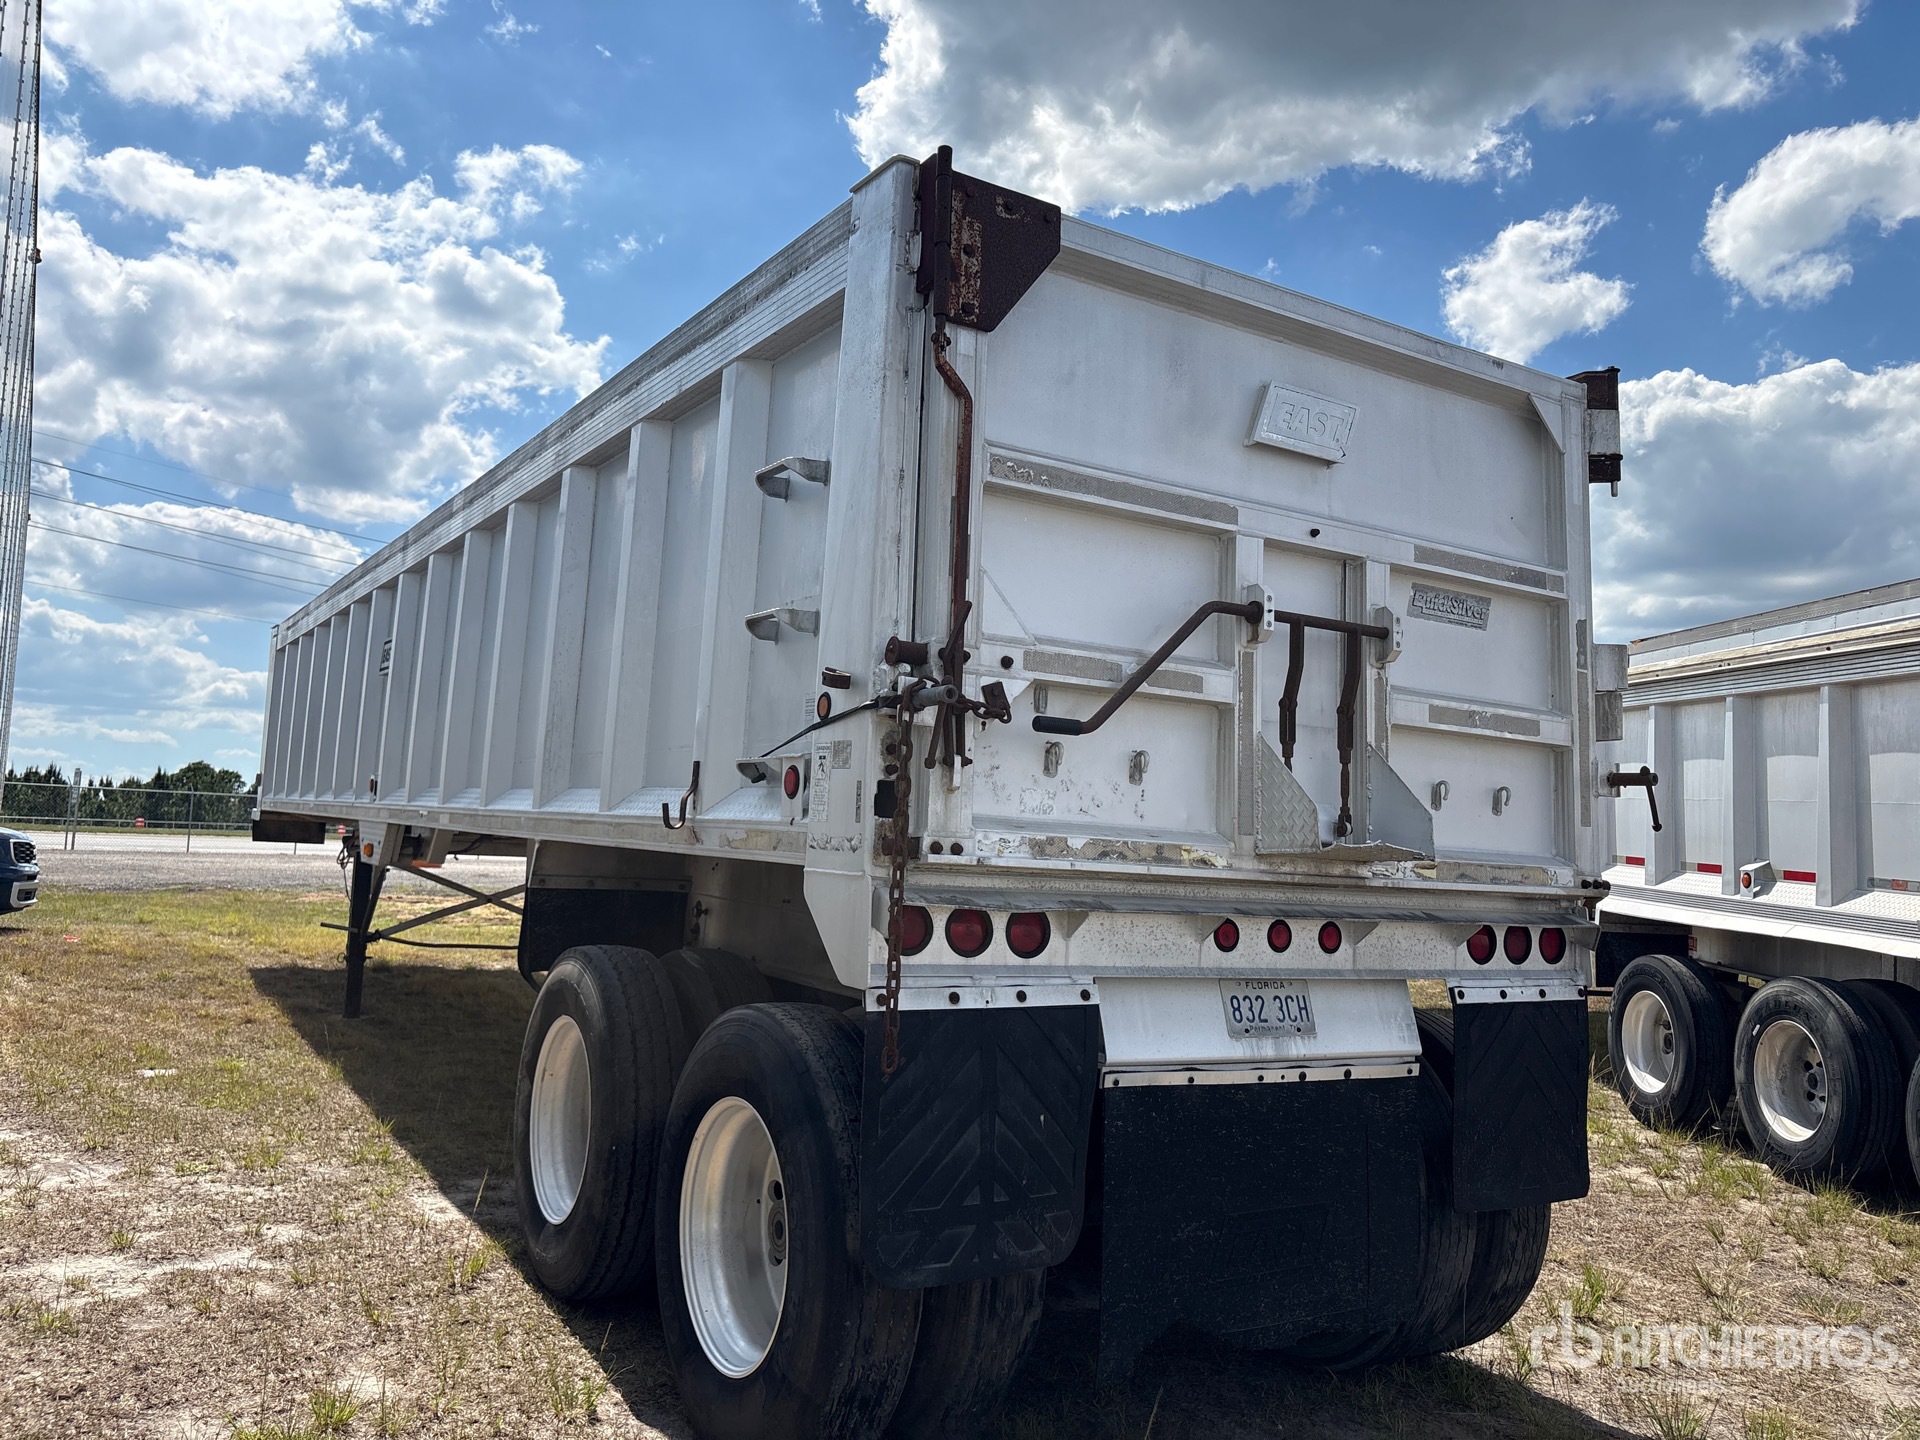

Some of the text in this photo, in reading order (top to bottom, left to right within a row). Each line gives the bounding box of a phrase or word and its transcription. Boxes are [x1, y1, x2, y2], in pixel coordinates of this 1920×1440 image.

[1245, 981, 1286, 990] FLORIDA
[1229, 994, 1310, 1024] 832 3CH
